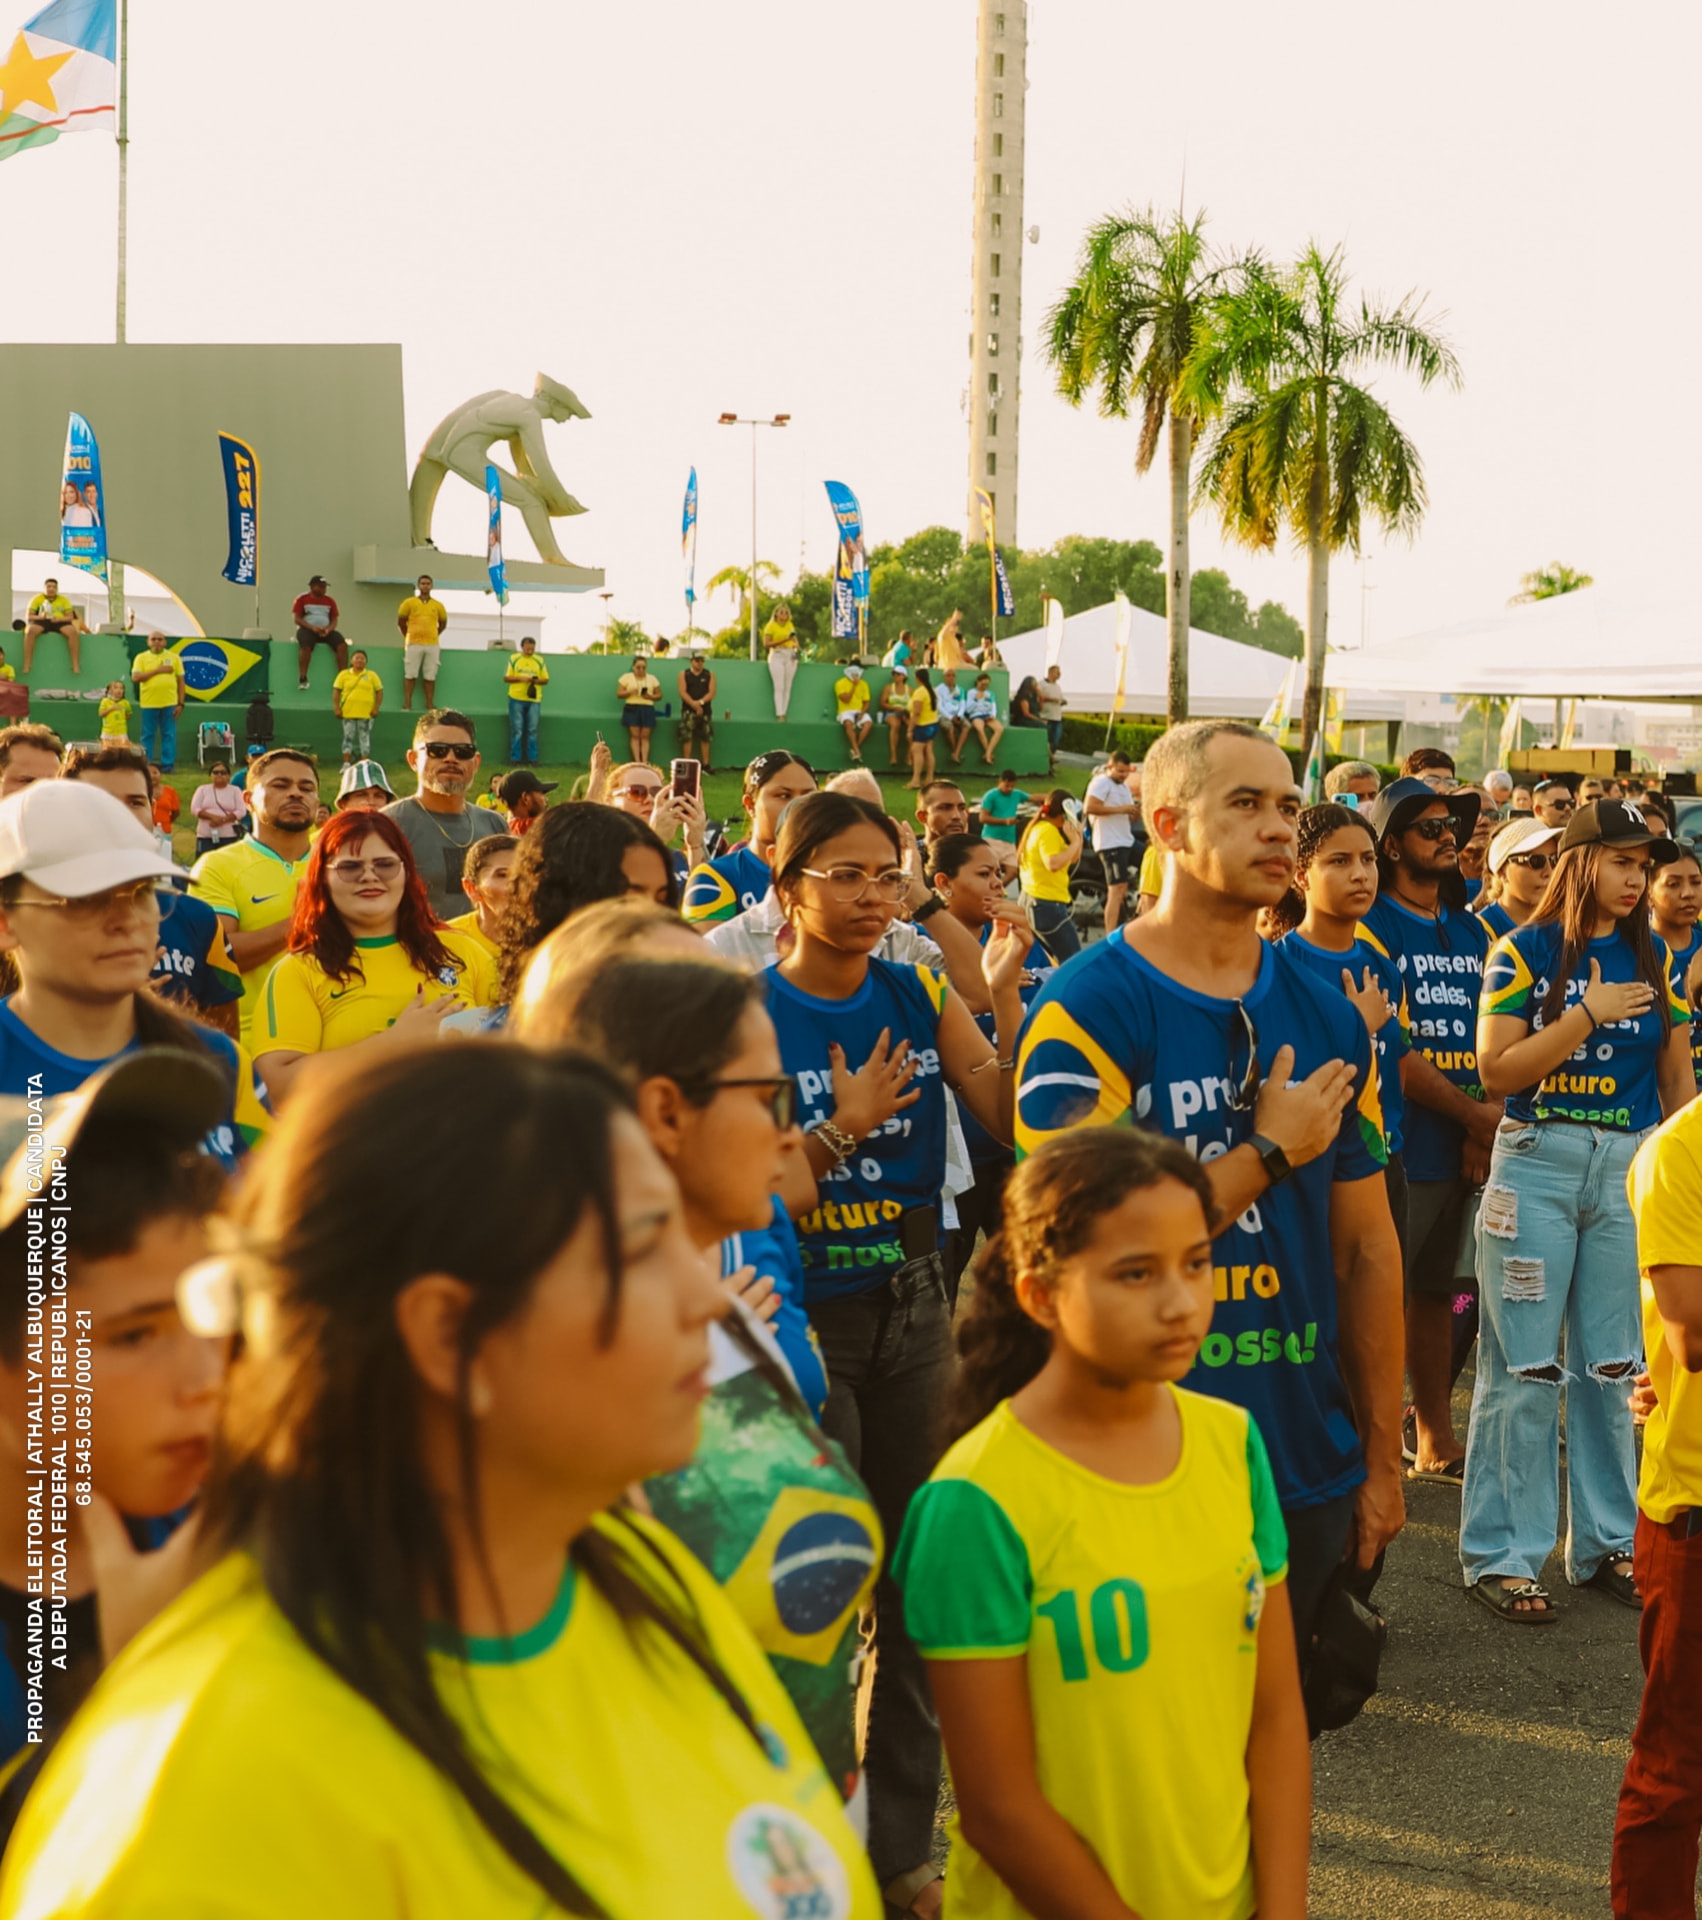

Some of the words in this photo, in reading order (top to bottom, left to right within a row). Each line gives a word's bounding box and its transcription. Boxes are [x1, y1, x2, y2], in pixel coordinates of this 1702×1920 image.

[233, 452, 254, 509] 227
[235, 512, 250, 583] NICOLETTI
[1453, 1019, 1466, 1037] o
[1596, 1043, 1614, 1062] o
[1543, 1073, 1617, 1096] uturo
[861, 1157, 882, 1182] o
[799, 1200, 902, 1234] uturo
[1190, 1322, 1317, 1369] osso!
[1037, 1577, 1150, 1683] 10
